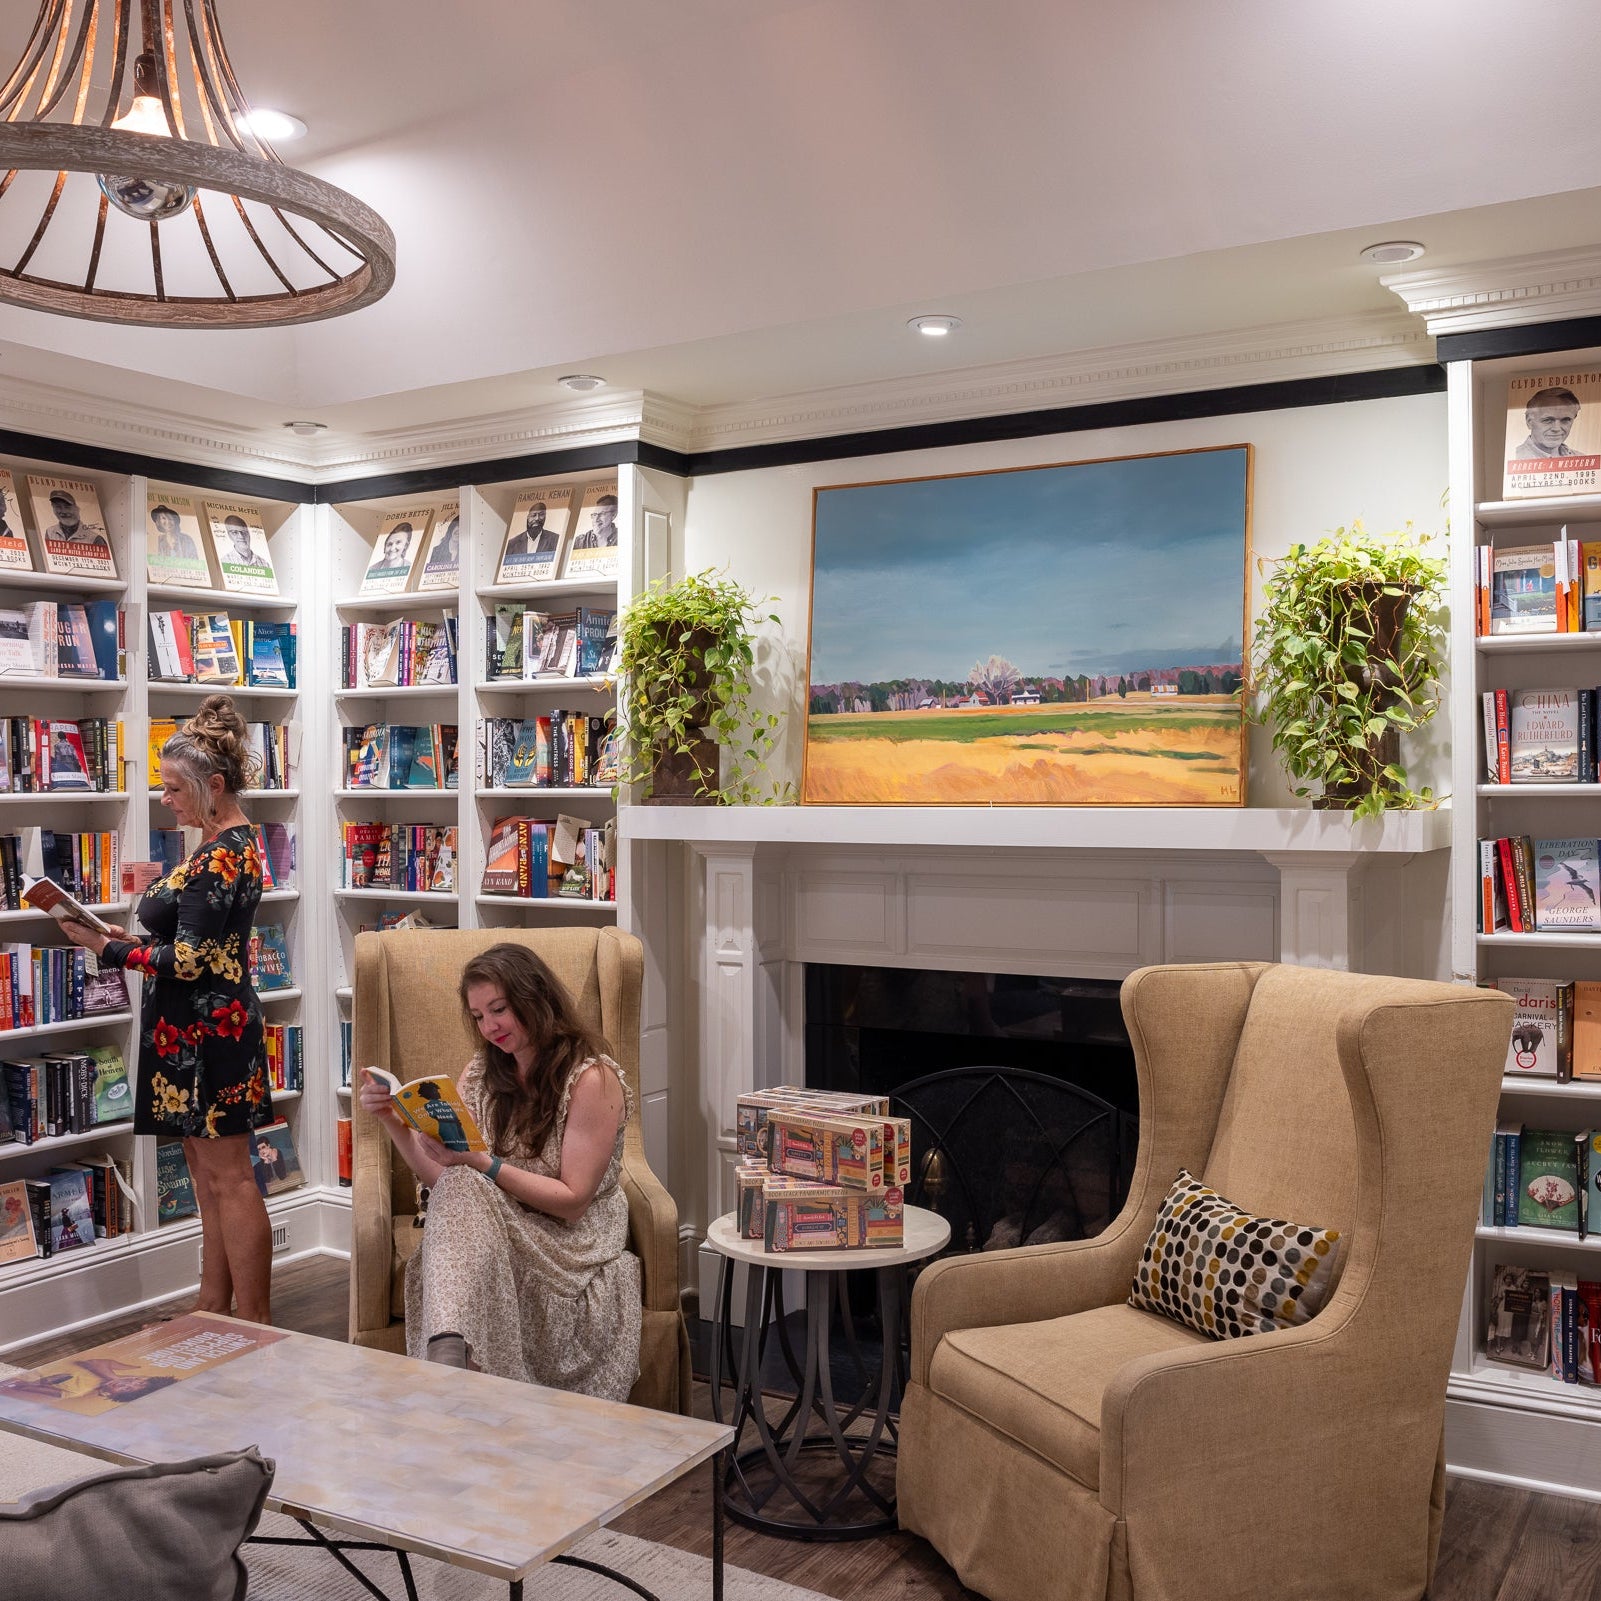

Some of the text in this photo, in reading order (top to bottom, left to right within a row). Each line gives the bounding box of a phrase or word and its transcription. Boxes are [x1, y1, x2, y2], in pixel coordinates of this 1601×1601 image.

[1511, 378, 1543, 389] CLYDE
[1559, 458, 1596, 468] WESTERN
[1511, 473, 1537, 481] APRIL
[1575, 470, 1597, 478] 1995
[29, 475, 95, 492] BLAND SIMPSON
[1568, 478, 1596, 486] BOOKS
[518, 489, 571, 502] RANDALL KENAN
[206, 502, 237, 512] MICHAEL
[441, 503, 455, 512] JILL
[385, 509, 430, 520] DORIS BETTS
[230, 565, 266, 576] COLANDER
[57, 622, 87, 634] UGAR
[58, 634, 81, 646] RUN
[1522, 693, 1571, 709] CHINA
[50, 723, 78, 733] RAPEZE
[1526, 720, 1565, 731] EDWARD
[1539, 839, 1595, 849] LIBERATION
[519, 822, 528, 888] AYN RAND
[496, 877, 513, 886] RAND
[1549, 906, 1589, 914] GEORGE
[1543, 916, 1594, 924] SAUNDERS
[257, 951, 287, 963] OBACCO
[259, 962, 286, 974] WIVES
[99, 1055, 119, 1064] South
[99, 1067, 124, 1076] Heaven
[426, 1101, 439, 1109] Are
[157, 1147, 183, 1160] Nordan
[157, 1163, 177, 1175] usic
[157, 1176, 190, 1194] Swamp
